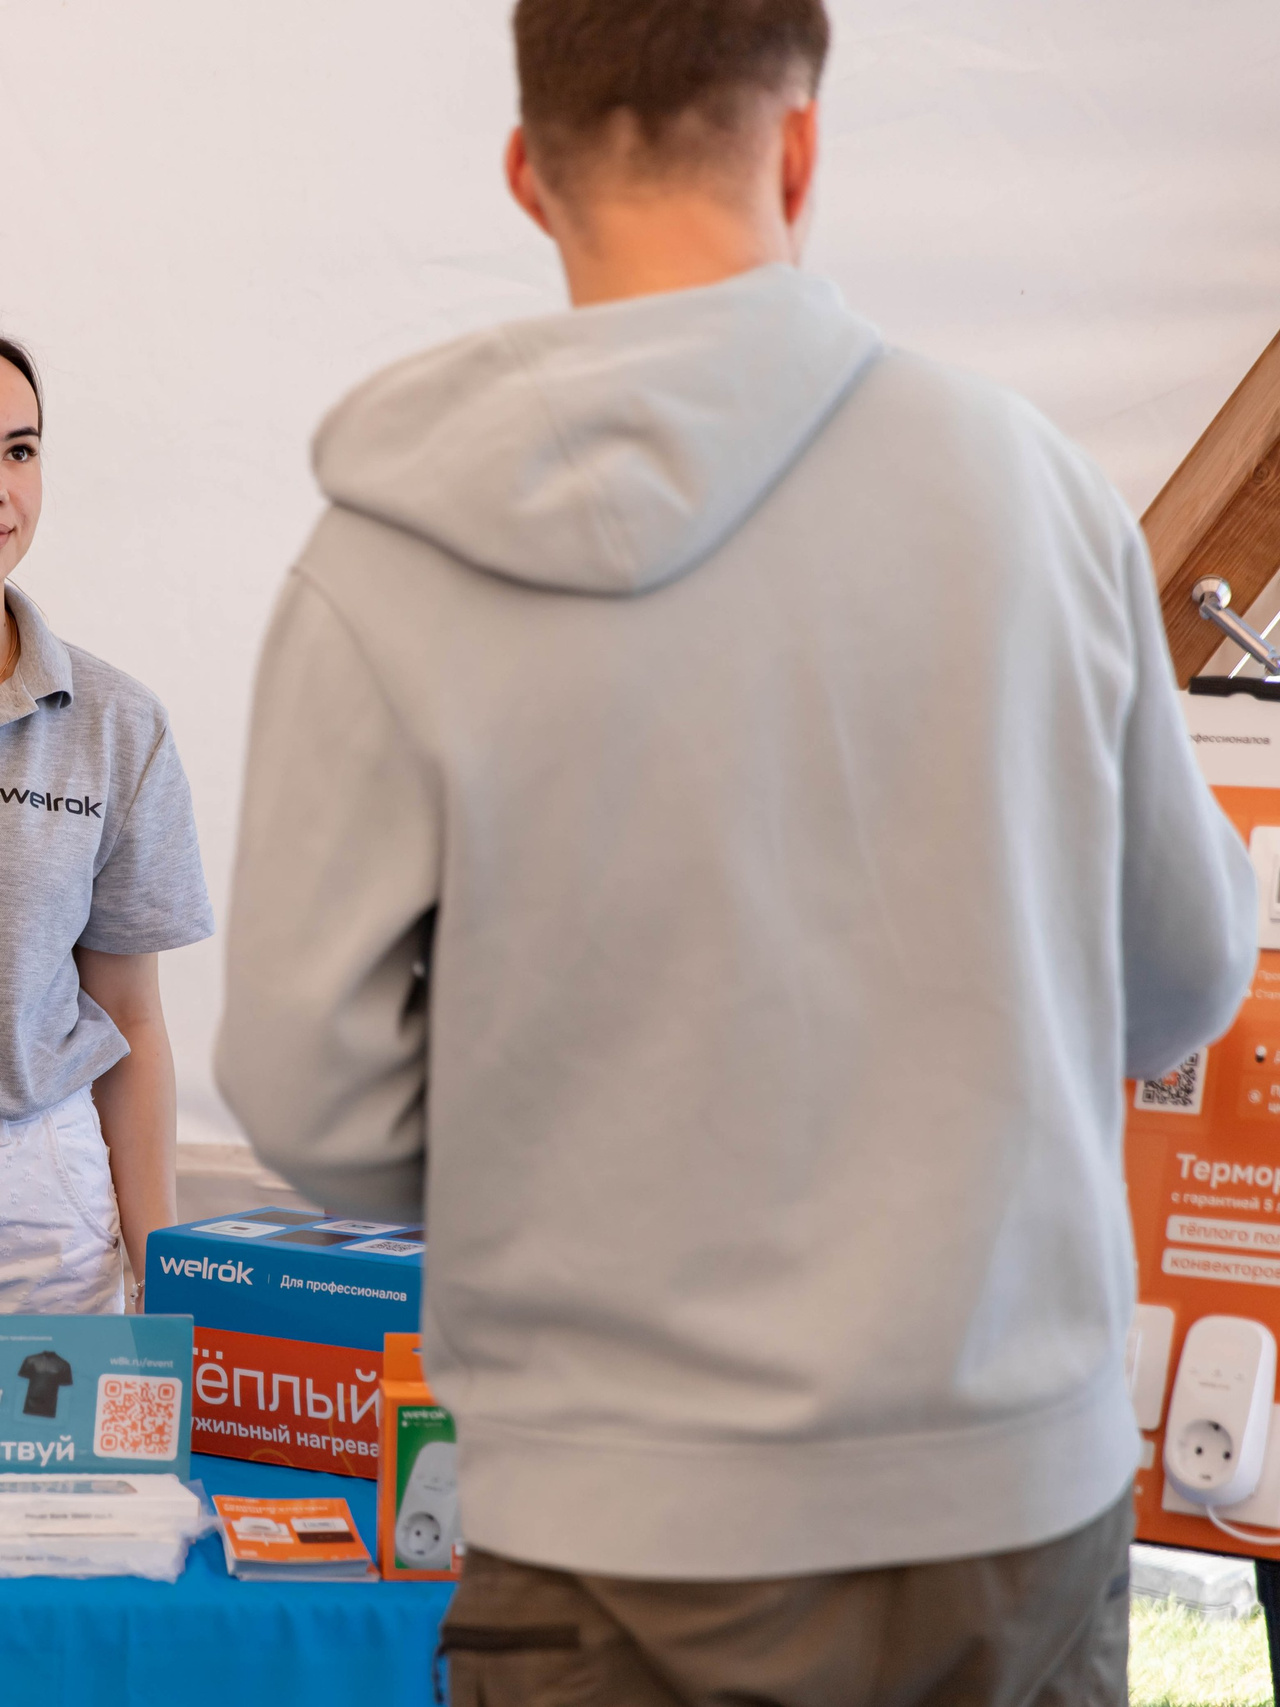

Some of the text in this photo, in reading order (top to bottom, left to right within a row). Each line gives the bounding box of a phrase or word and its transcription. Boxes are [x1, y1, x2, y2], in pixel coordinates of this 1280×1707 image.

[0, 788, 102, 818] welrok
[280, 1274, 407, 1301] Для профессионалов
[193, 1347, 380, 1427] ёплый
